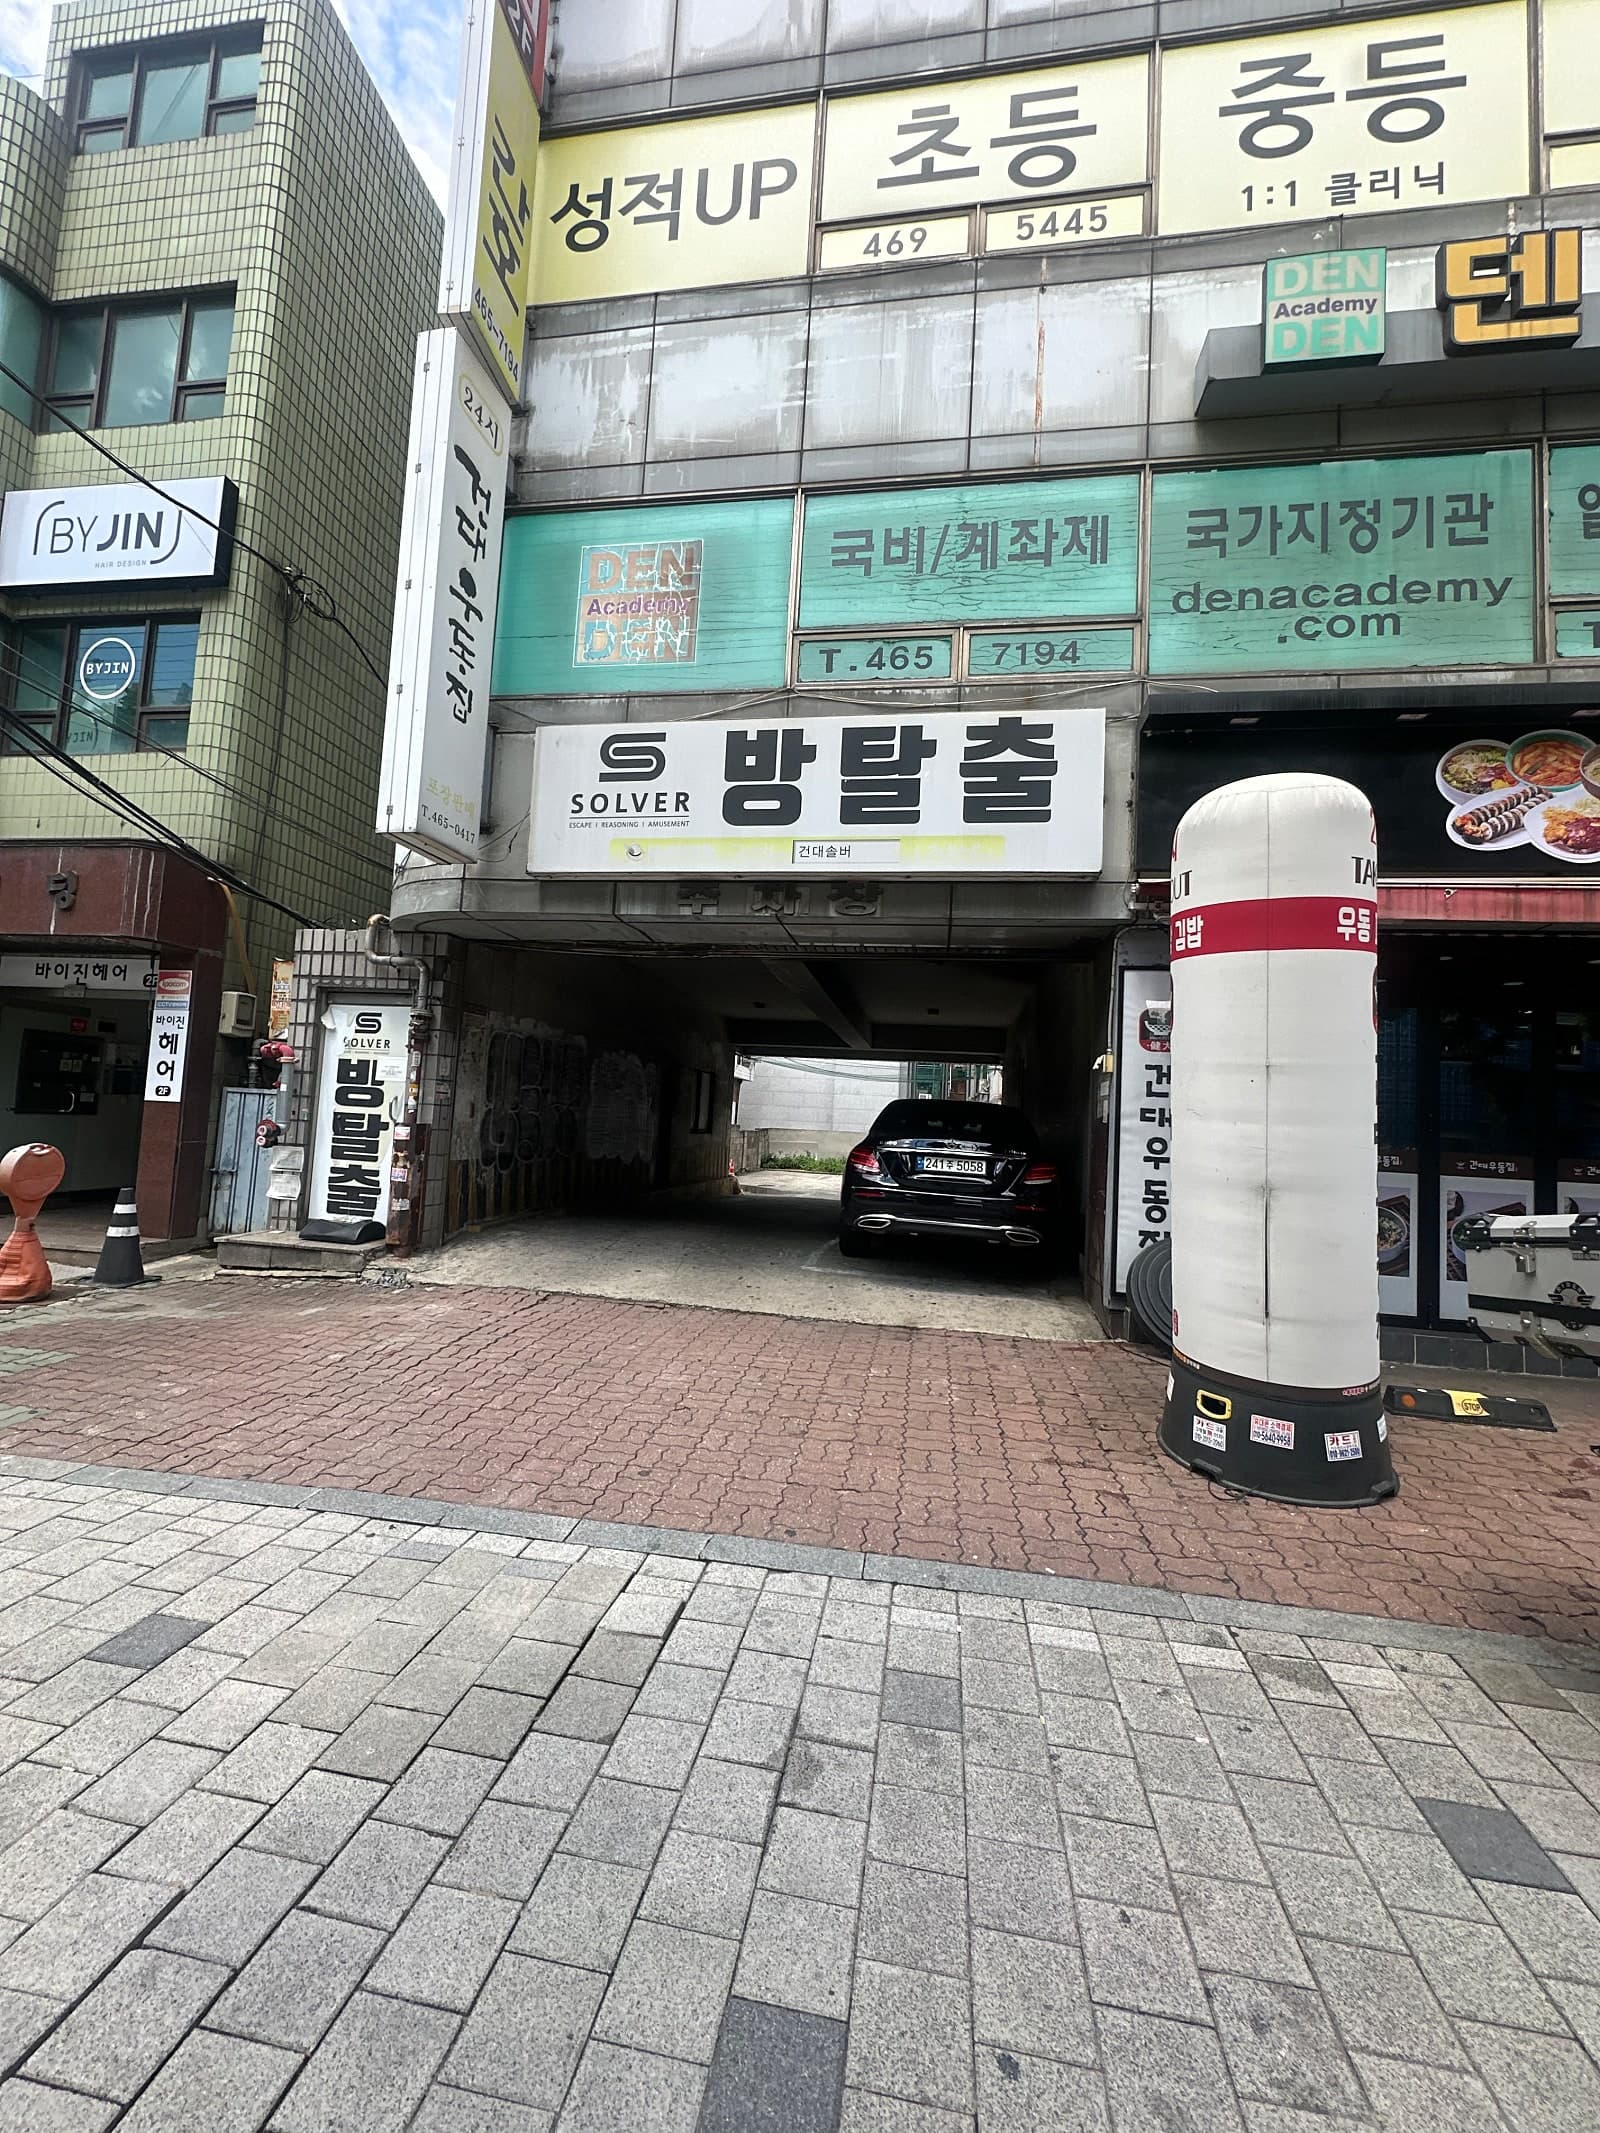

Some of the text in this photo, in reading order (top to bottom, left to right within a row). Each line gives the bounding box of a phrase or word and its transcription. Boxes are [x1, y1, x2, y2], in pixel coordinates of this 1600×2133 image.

[1219, 33, 1468, 159] 중등
[877, 86, 1098, 190] 초등
[1325, 161, 1445, 207] 클리닉
[482, 112, 530, 317] 간호
[550, 158, 797, 254] 성적UP
[1015, 204, 1108, 241] 5445
[863, 226, 928, 259] 469
[1274, 254, 1379, 298] DEN
[1439, 226, 1583, 351] 덴
[1273, 297, 1378, 319] Academy
[474, 287, 519, 383] 465-7194
[1271, 315, 1379, 359] DEN
[463, 385, 499, 450] 24시
[1186, 491, 1495, 559] 국가지정기관
[94, 559, 147, 569] HAIR DESIGN
[588, 547, 695, 592] DEN
[587, 595, 689, 616] Academy
[1171, 574, 1514, 616] denacademy
[86, 662, 130, 675] BYJIN
[992, 639, 1081, 667] 7194
[721, 716, 1058, 828] 방탈출
[570, 791, 690, 816] SOLVER
[601, 821, 639, 829] REASONING
[647, 820, 690, 828] AMUSEMENT
[797, 844, 853, 859] 건대솔버
[1175, 914, 1205, 952] 김밥
[1336, 905, 1371, 944] 우동
[35, 963, 128, 985] 바이진헤어
[155, 1015, 186, 1030] 바이진
[157, 1086, 170, 1096] 2F
[326, 1058, 390, 1218] 방탈출
[1463, 1402, 1481, 1412] STOP
[1329, 1435, 1351, 1446] 카드
